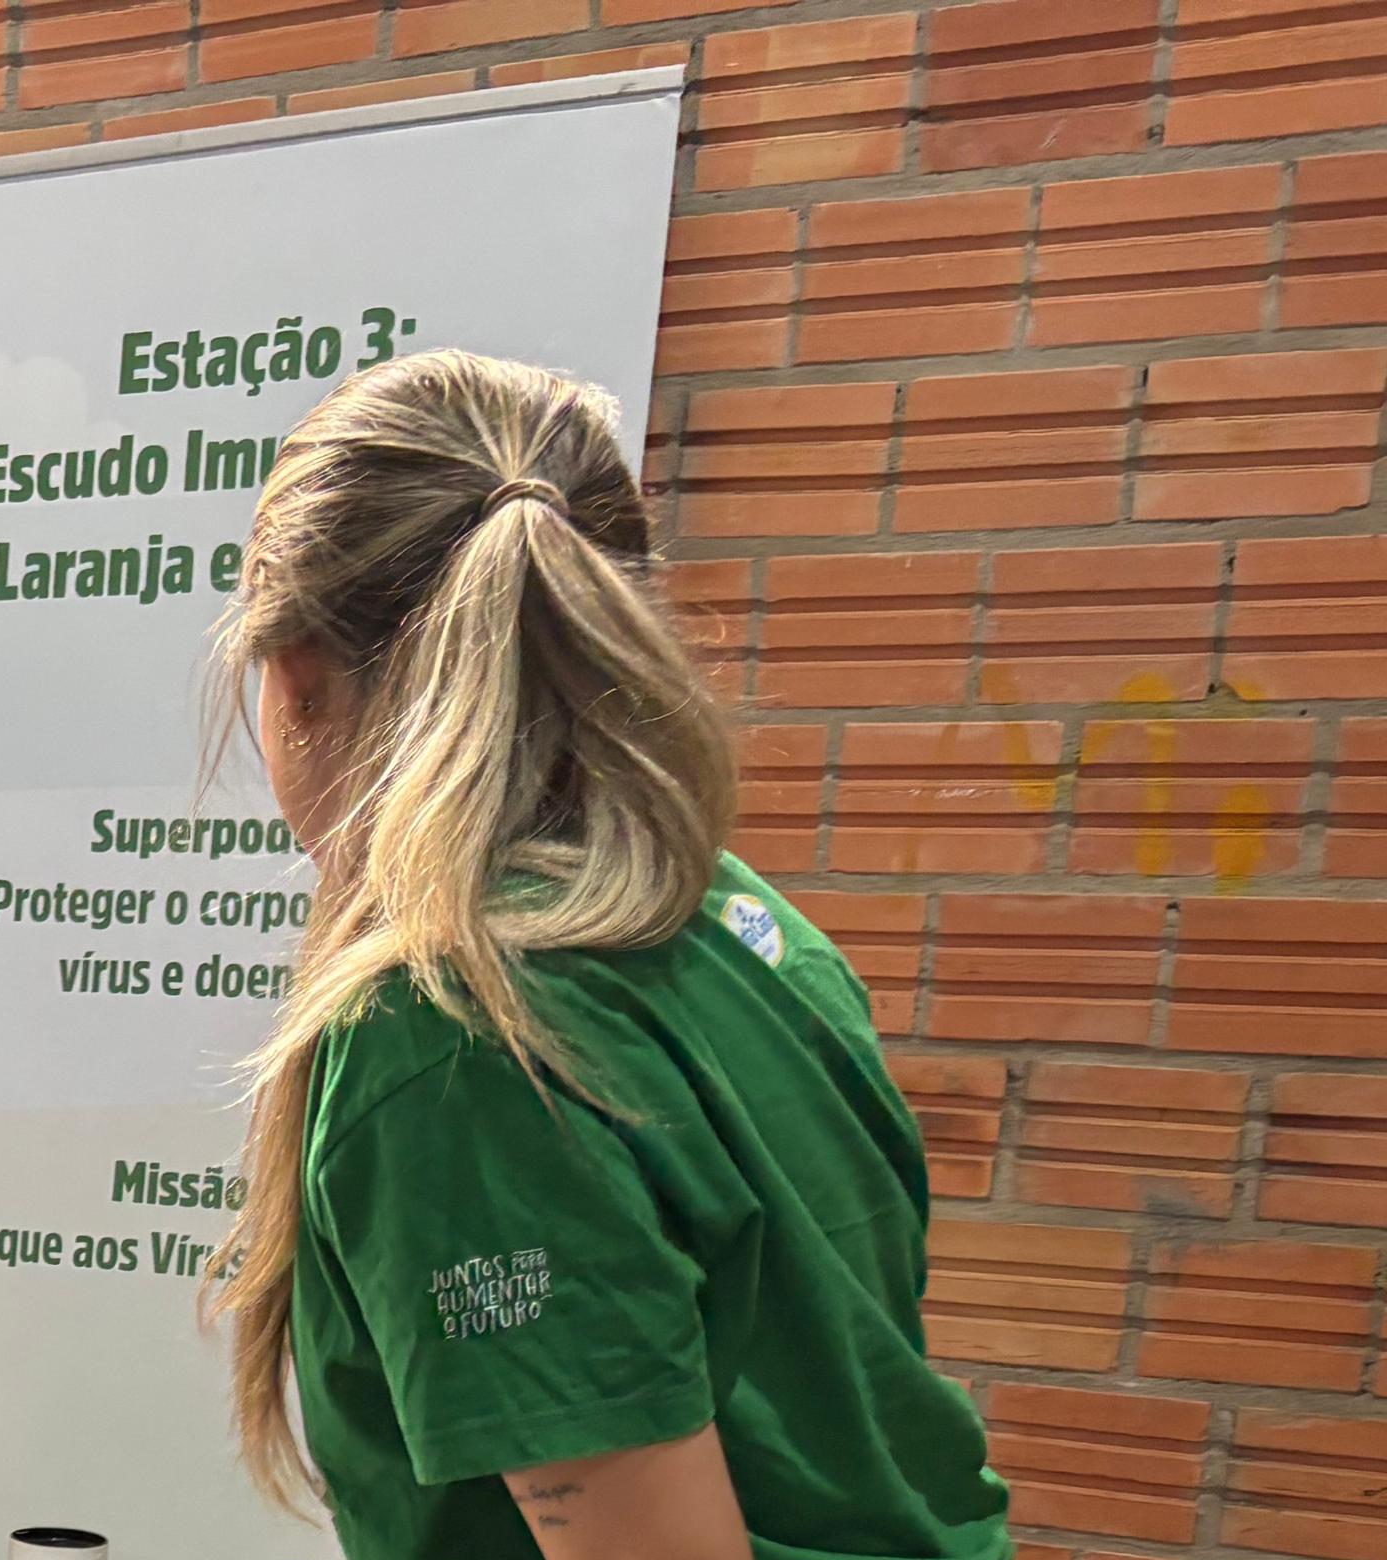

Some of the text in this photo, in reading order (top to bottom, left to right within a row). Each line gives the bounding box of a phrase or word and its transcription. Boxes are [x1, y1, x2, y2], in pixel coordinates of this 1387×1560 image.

[118, 316, 341, 397] Estação
[211, 542, 243, 593] e
[90, 809, 303, 860] Superpod
[165, 890, 188, 926] o
[200, 889, 311, 934] corpo
[59, 951, 290, 1000] vírus e doen
[73, 1234, 138, 1272] aos
[461, 1300, 542, 1339] FUTURO
